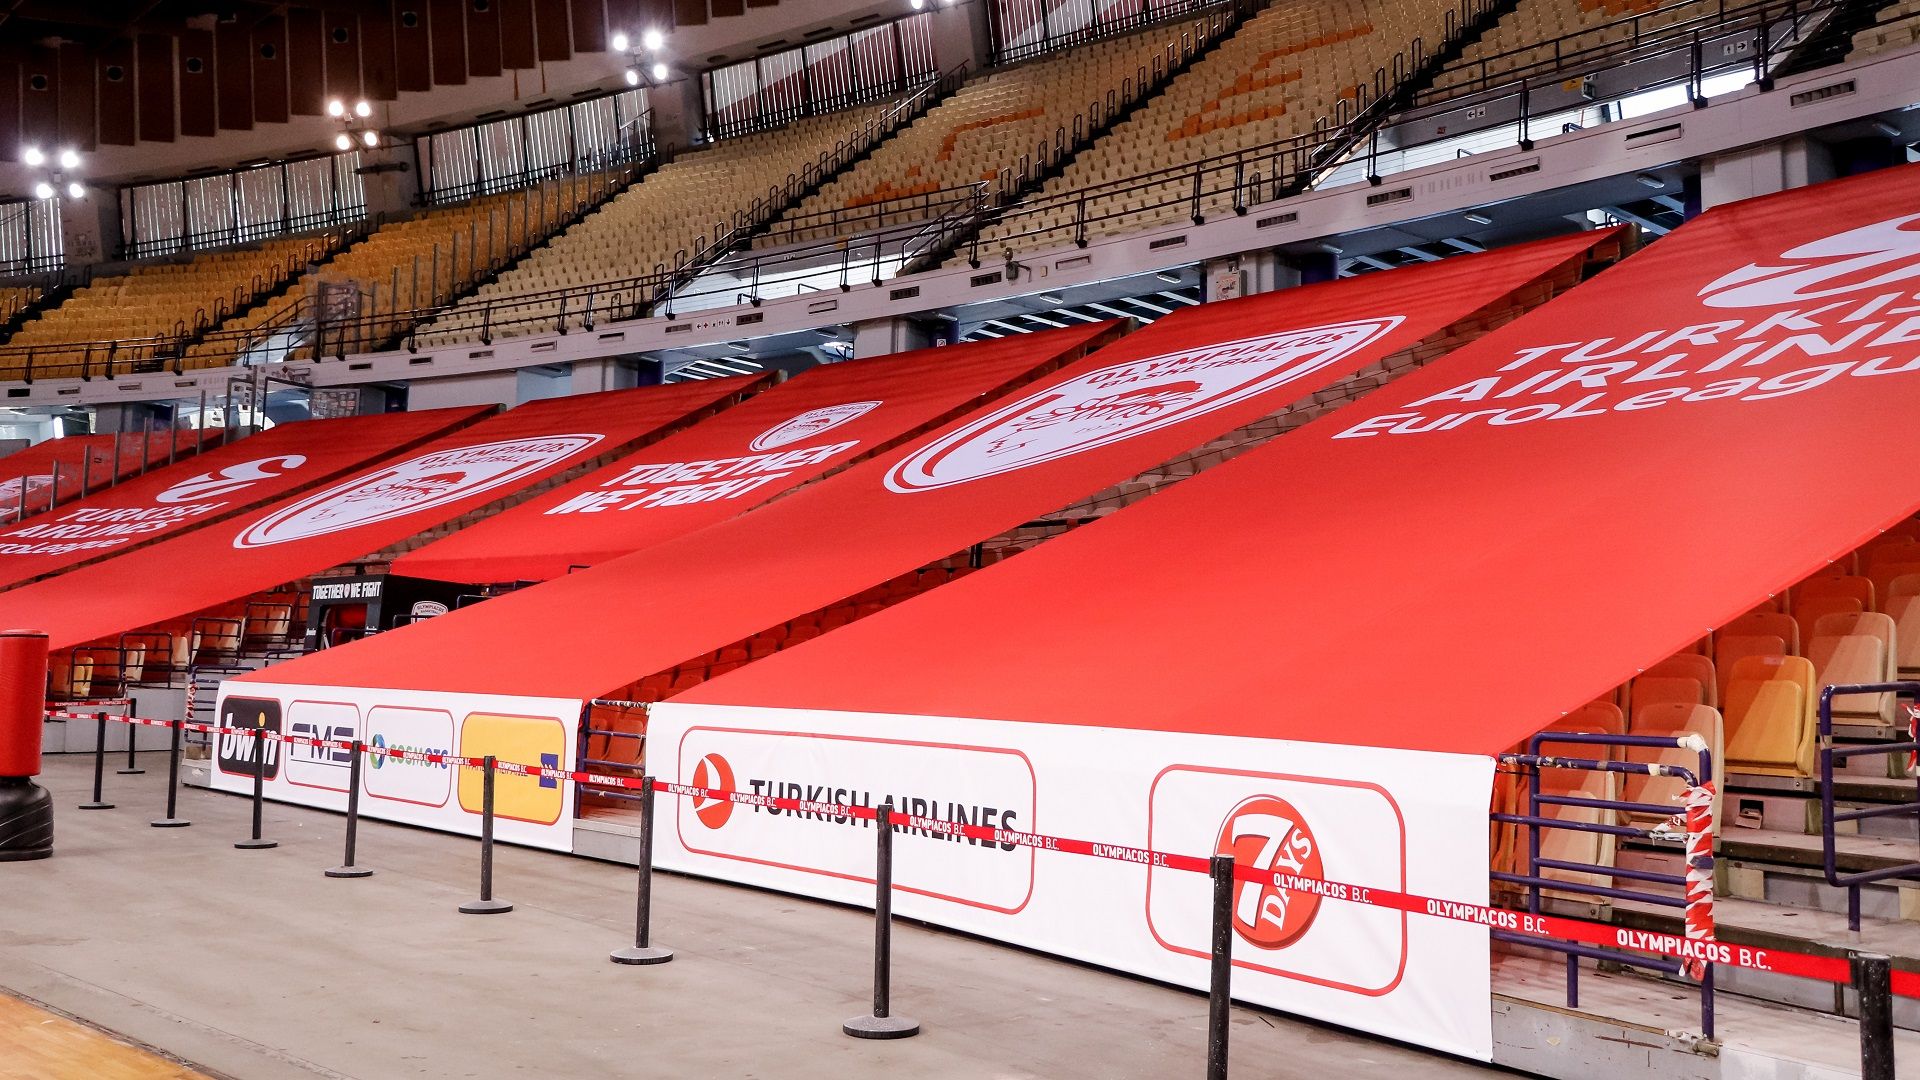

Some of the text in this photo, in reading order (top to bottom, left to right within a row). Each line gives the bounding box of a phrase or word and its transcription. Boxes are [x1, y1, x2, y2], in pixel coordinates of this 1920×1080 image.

[1086, 330, 1359, 385] OLYMPIACOS
[1097, 351, 1289, 389] BASKETBALL
[600, 440, 860, 487] TOGETHER
[543, 471, 793, 515] WE FIGHT
[56, 502, 230, 522] TURKISH
[0, 518, 184, 539] AIRLINES
[313, 581, 382, 600] TOGETHER WE FIGHT
[221, 712, 278, 766] bwn
[589, 774, 616, 786] OLYMPIACOS
[668, 783, 700, 797] OLYMPIACOS
[729, 792, 765, 806] OLYMPIACOS
[750, 779, 869, 828] TURKISH
[800, 800, 839, 815] OLYMPIACOS
[909, 816, 952, 834] OLYMPIACOS
[994, 831, 1043, 848] OLYMPIACOS
[1092, 843, 1169, 868] OLYMPIACOS B.C.
[1231, 812, 1295, 930] 7
[1273, 872, 1373, 904] OLYMPIACOS B.C.
[1426, 897, 1550, 936] OLYMPIACOS B.C.
[1616, 928, 1772, 972] OLYMPIACOS B.C.
